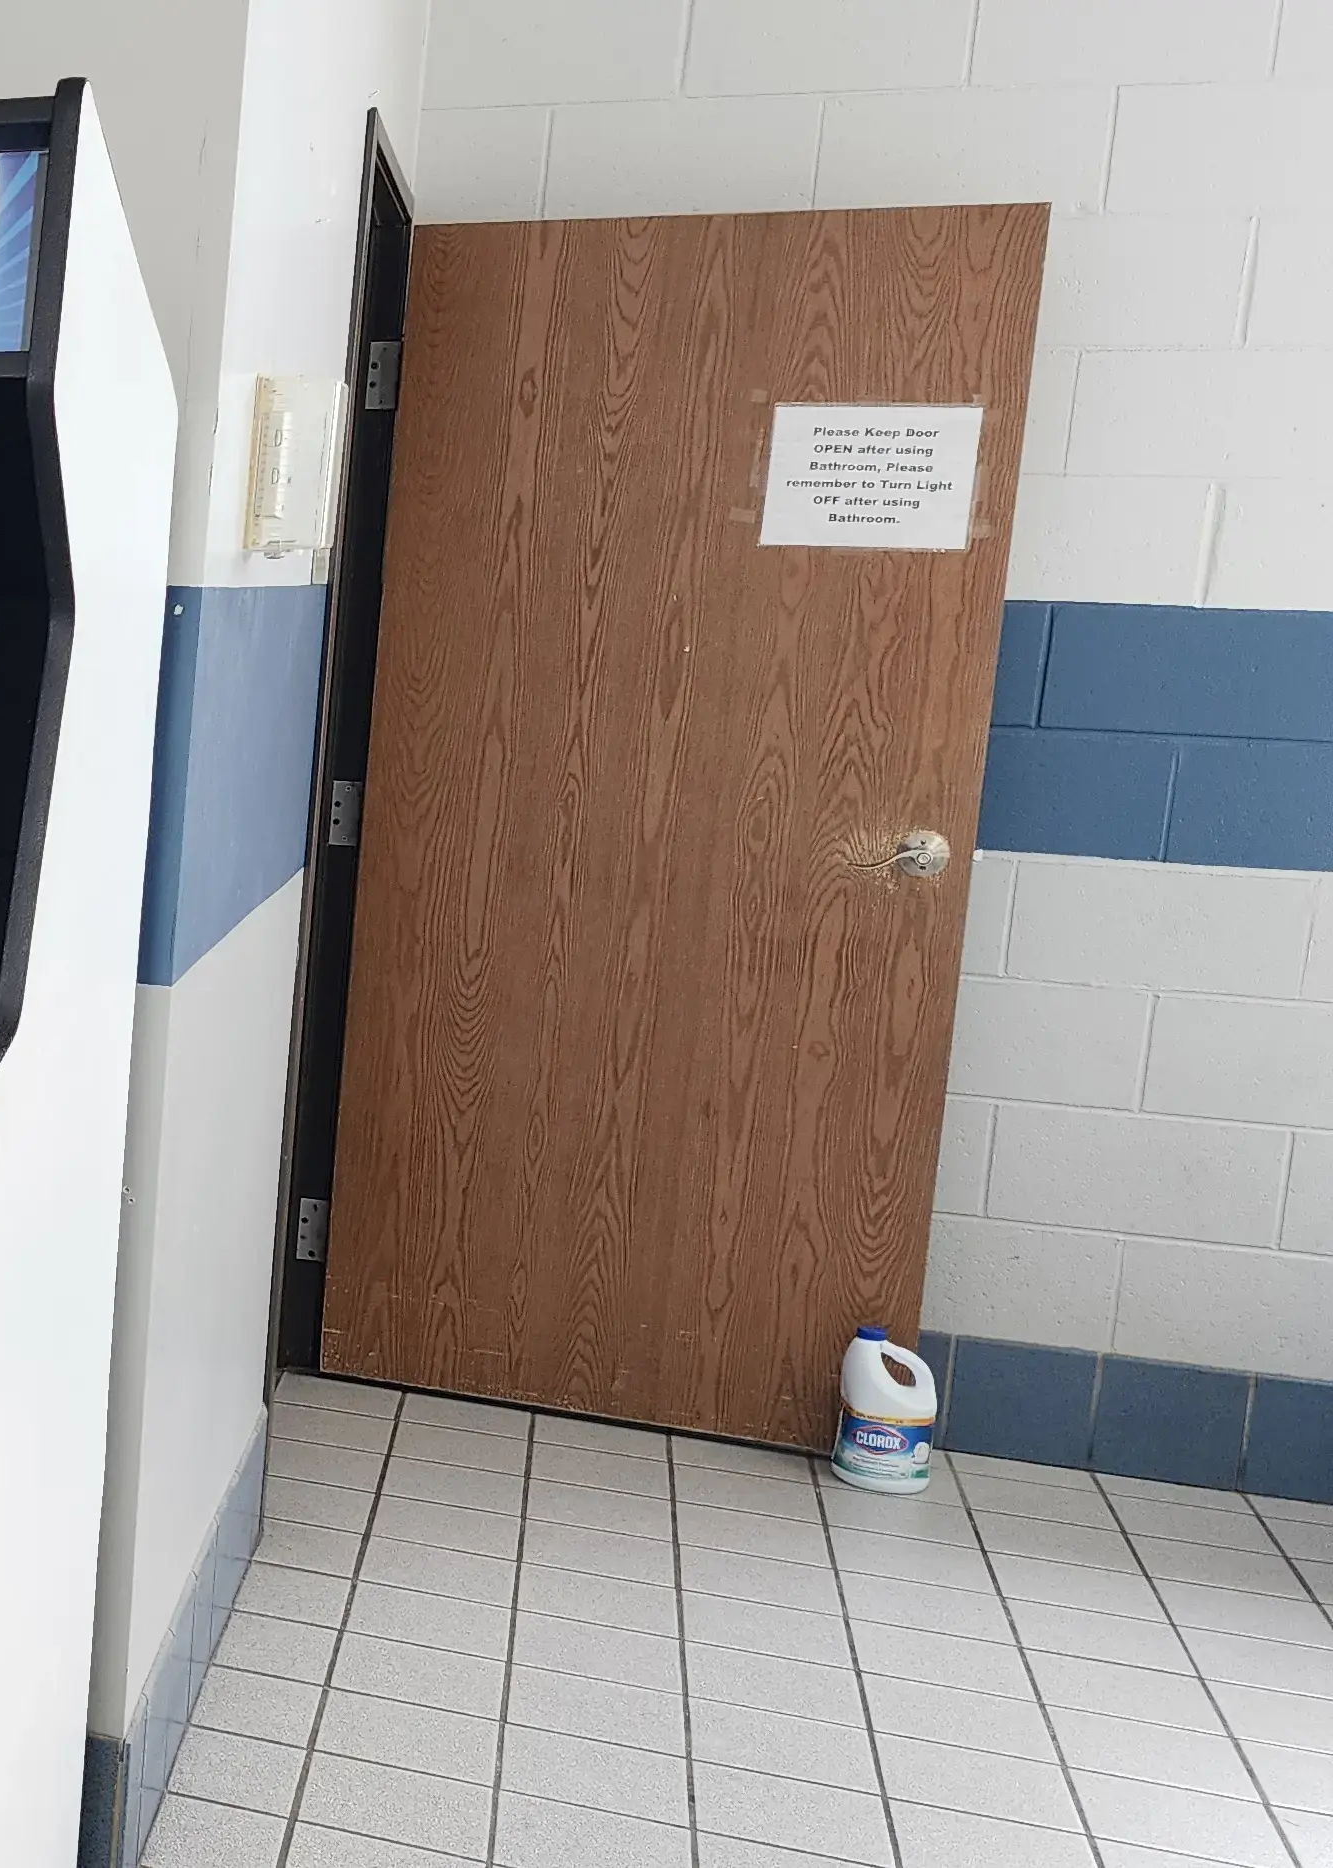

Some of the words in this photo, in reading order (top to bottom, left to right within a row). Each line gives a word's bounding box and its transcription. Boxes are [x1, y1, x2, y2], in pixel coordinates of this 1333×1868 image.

[813, 427, 860, 437] Please
[864, 428, 901, 439] Keep
[905, 428, 939, 438] Door
[813, 444, 853, 454] OPEN
[857, 445, 892, 455] after
[895, 446, 934, 457] using
[809, 462, 882, 473] Bathroom,
[886, 462, 934, 473] Please
[786, 479, 857, 489] remember
[862, 480, 875, 489] to
[880, 480, 912, 490] Turn
[916, 480, 953, 492] Light
[813, 496, 841, 505] OFF
[844, 496, 879, 506] after
[883, 498, 920, 509] using
[828, 513, 901, 524] Bathroom.
[855, 1430, 903, 1451] CLOROX
